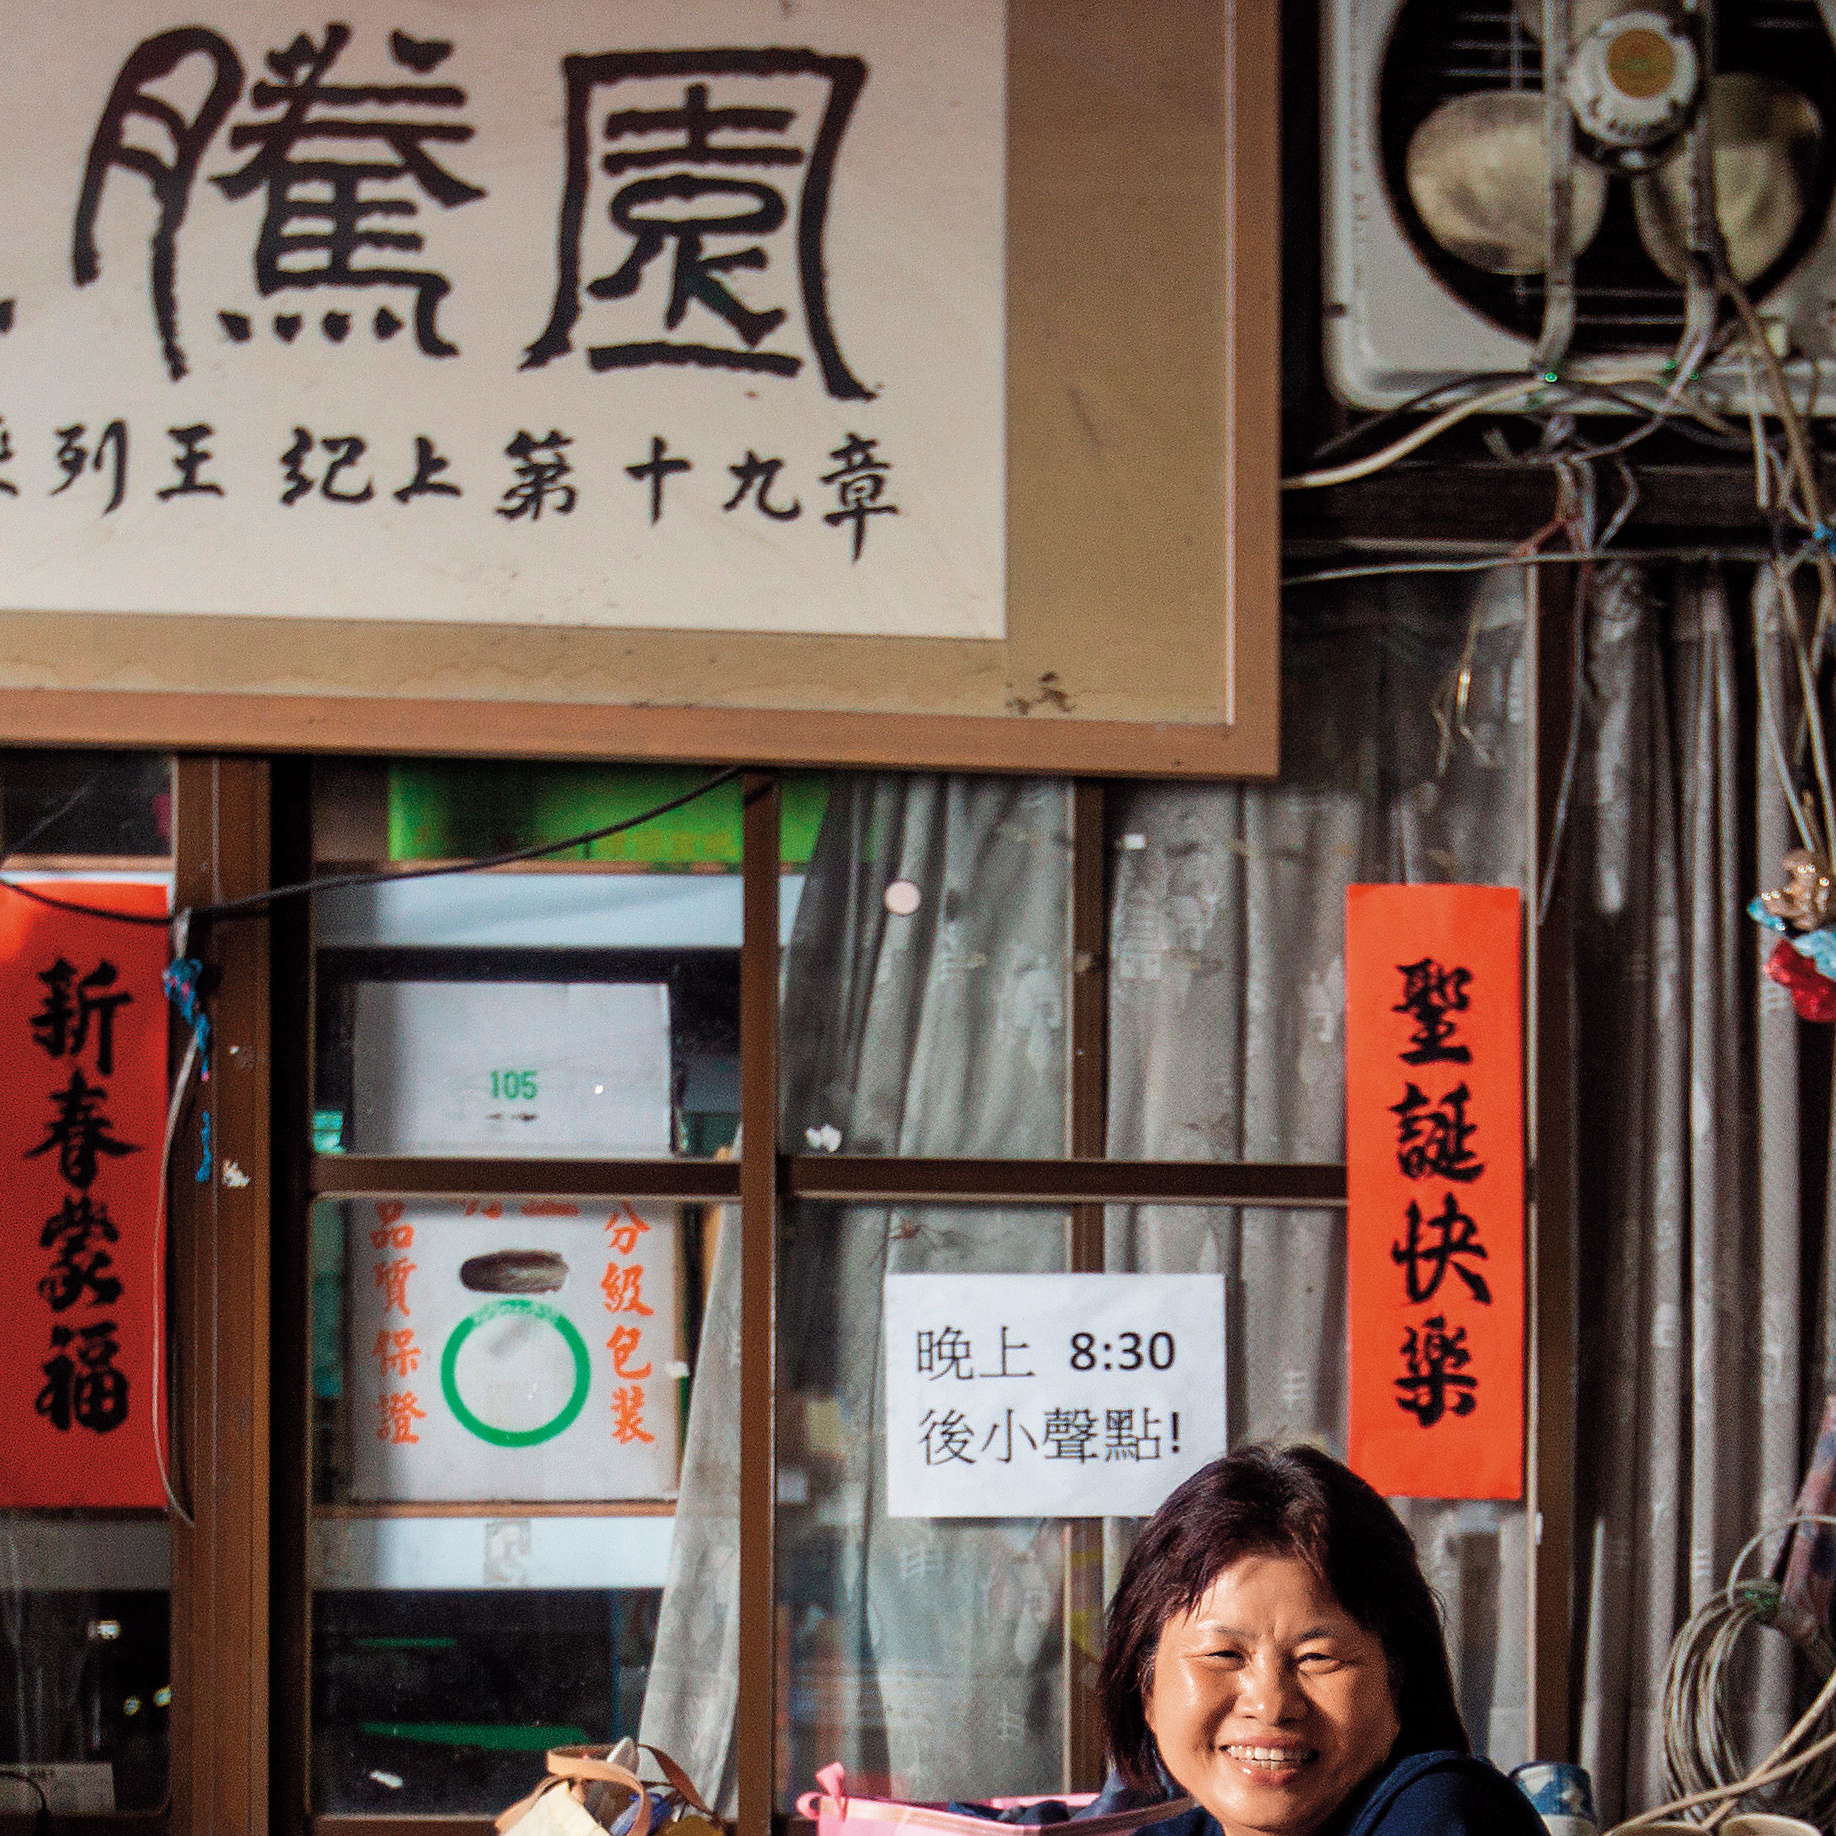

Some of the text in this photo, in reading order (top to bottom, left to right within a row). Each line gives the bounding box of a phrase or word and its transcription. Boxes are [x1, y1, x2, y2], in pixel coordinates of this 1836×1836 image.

[25, 958, 143, 1433] 新春蒙福
[489, 1068, 539, 1101] 105
[1390, 957, 1493, 1429] 聖誕快樂
[369, 1200, 427, 1445] 品質保證
[600, 1200, 656, 1445] 分級包裝
[916, 1326, 1177, 1382] 晚上 8:30
[917, 1407, 1182, 1466] 後小聲點!
